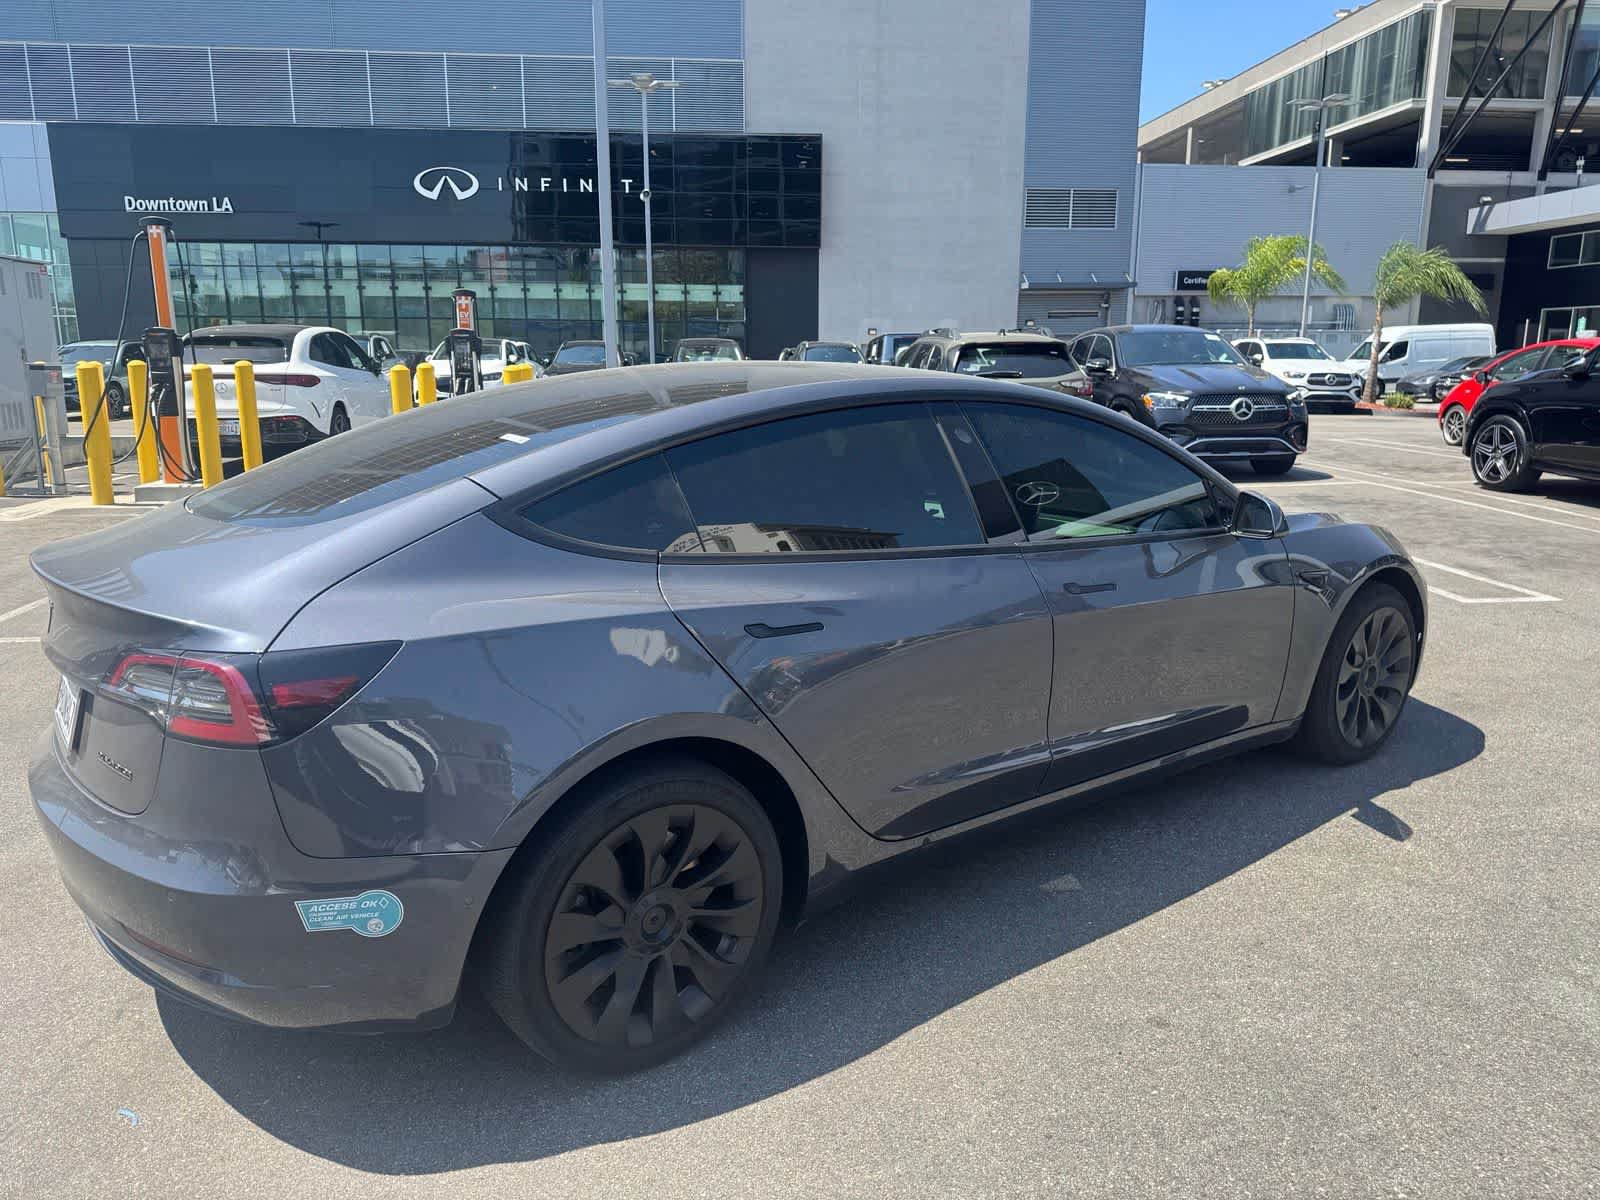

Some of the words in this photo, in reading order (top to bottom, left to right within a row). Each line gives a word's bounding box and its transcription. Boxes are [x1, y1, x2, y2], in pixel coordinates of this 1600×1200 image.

[498, 177, 646, 193] INFINT
[124, 195, 208, 211] Downtown
[212, 197, 233, 212] LA
[310, 902, 357, 912] ACCESS
[361, 900, 378, 909] OK
